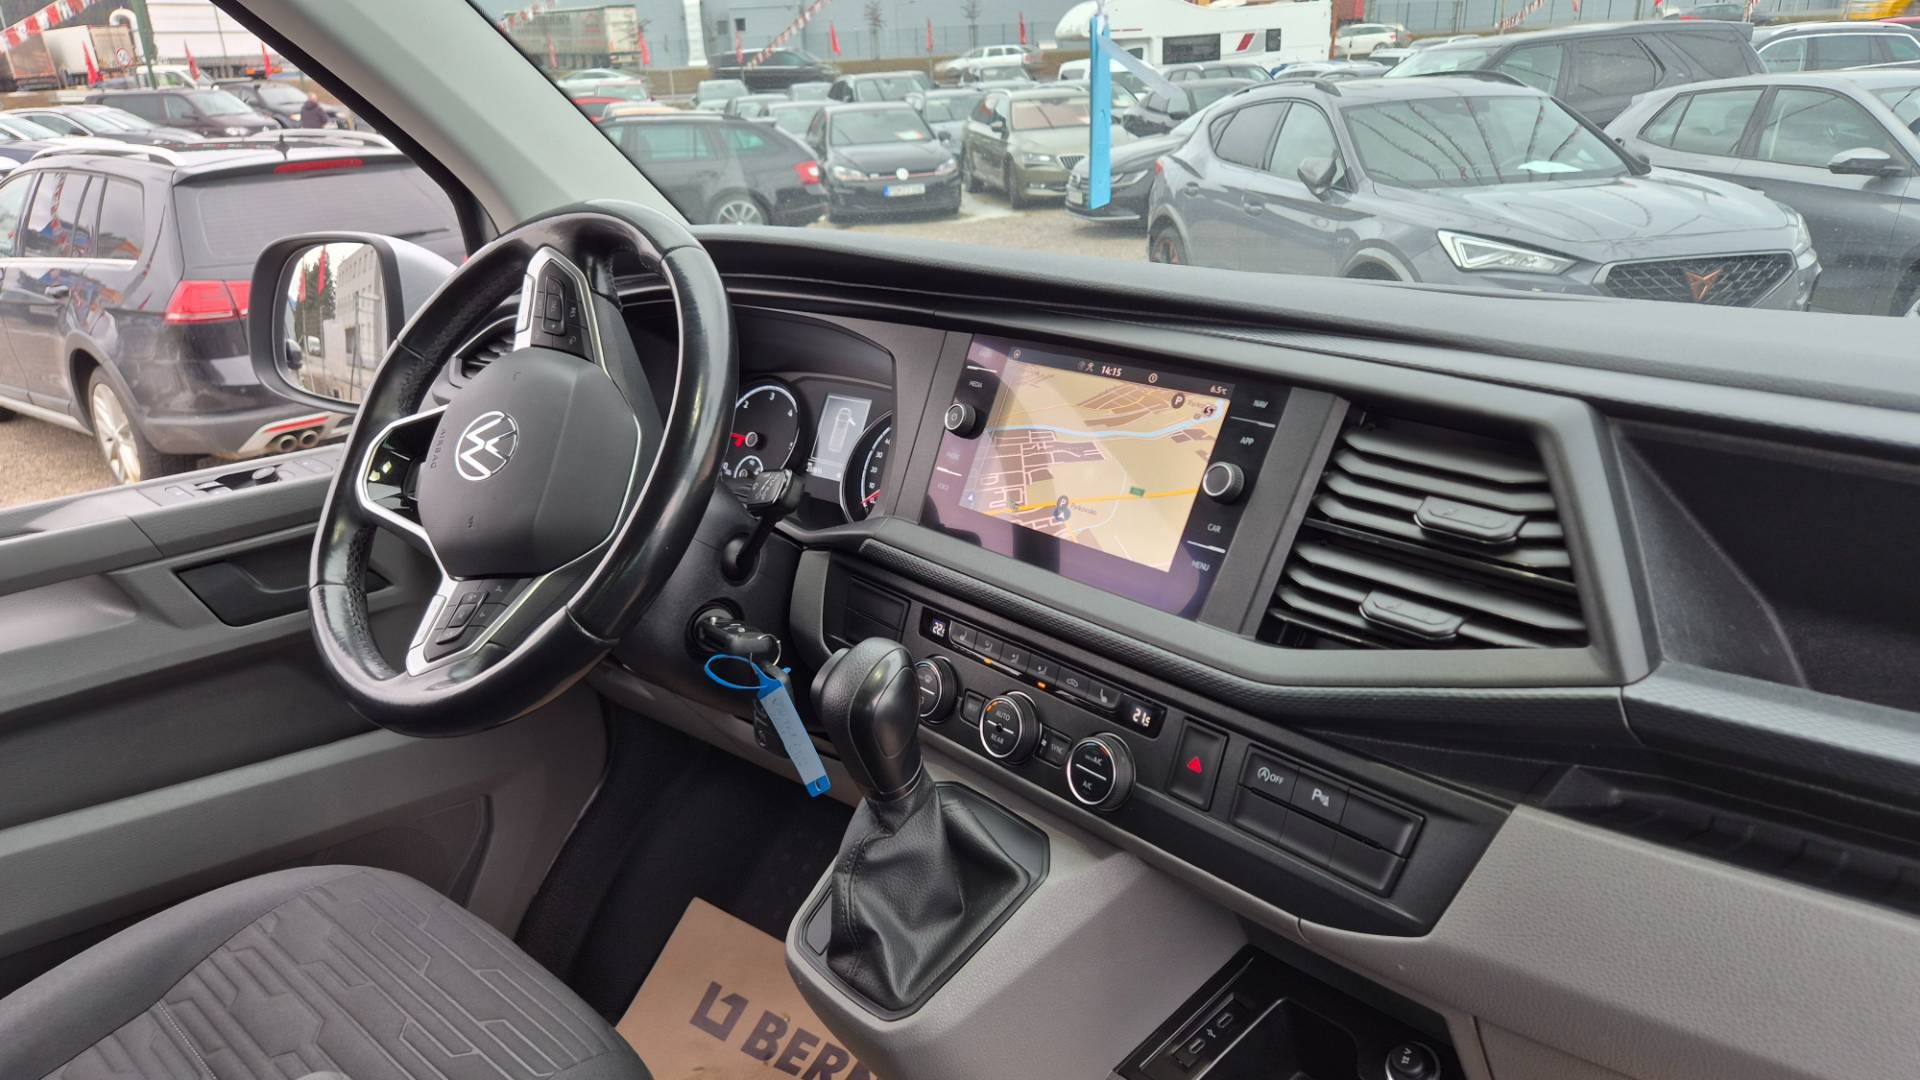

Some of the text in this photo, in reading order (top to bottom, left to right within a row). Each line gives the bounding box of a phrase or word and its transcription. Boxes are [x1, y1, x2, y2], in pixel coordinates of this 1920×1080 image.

[1101, 365, 1121, 377] 14:15
[769, 391, 776, 401] 3
[742, 400, 749, 409] 2
[1240, 436, 1255, 446] APP
[1207, 522, 1222, 533] CAR
[1191, 560, 1211, 572] MENU
[996, 710, 1011, 721] AUTO
[1269, 773, 1284, 785] OFF
